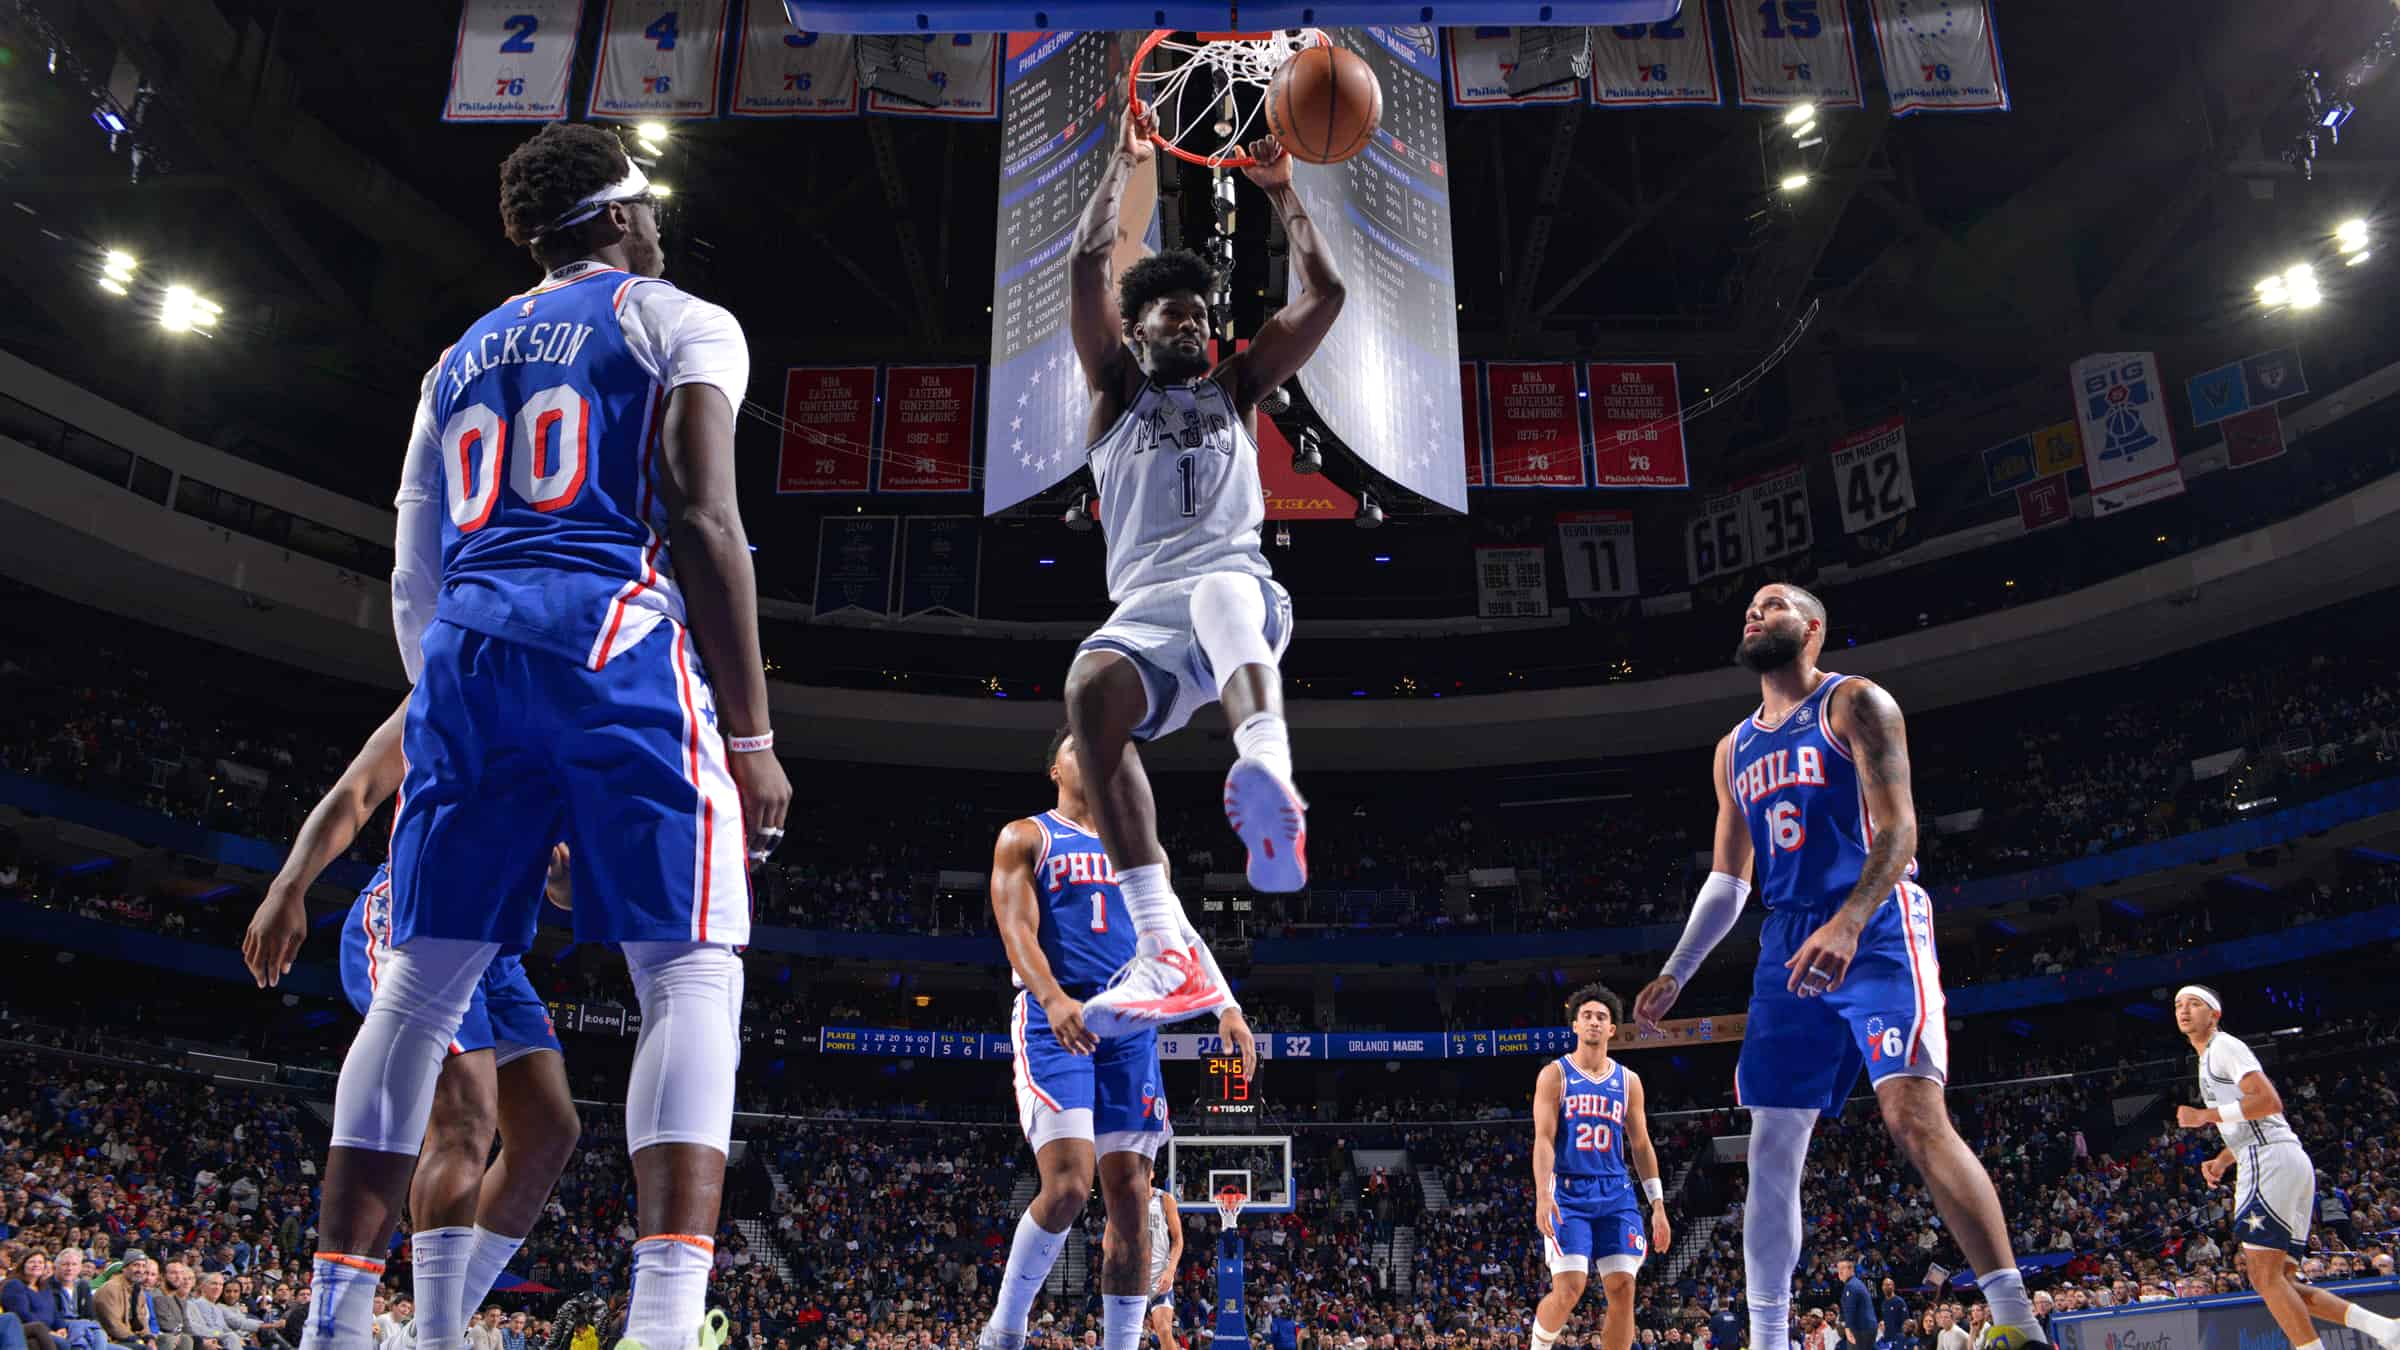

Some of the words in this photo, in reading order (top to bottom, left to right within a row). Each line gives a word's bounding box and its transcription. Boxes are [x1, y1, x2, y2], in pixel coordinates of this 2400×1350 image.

[500, 14, 538, 53] 2
[645, 12, 679, 50] 4
[1637, 64, 1667, 82] 76
[1782, 64, 1811, 81] 76
[1921, 64, 1951, 82] 76
[496, 78, 524, 96] 76
[641, 76, 671, 93] 76
[784, 73, 811, 91] 76
[458, 102, 524, 112] Philadelphia
[447, 322, 594, 401] JACKSON
[2086, 361, 2144, 394] BIG
[808, 388, 852, 399] EASTERN
[908, 387, 952, 399] EASTERN
[1511, 384, 1557, 394] EASTERN
[1611, 384, 1654, 395] EASTERN
[800, 400, 859, 411] CONFERENCE
[899, 400, 960, 411] CONFERENCE
[1504, 396, 1565, 407] CONFERENCE
[1604, 396, 1664, 407] CONFERENCE
[800, 412, 857, 423] CHAMPIONS
[901, 411, 958, 422] CHAMPIONS
[1506, 408, 1563, 419] CHAMPIONS
[1608, 408, 1664, 419] CHAMPIONS
[442, 384, 590, 534] 00
[815, 460, 836, 474] 76
[1528, 456, 1550, 470] 76
[1176, 454, 1196, 518] 1
[1848, 452, 1907, 523] 42
[1761, 490, 1808, 555] 35
[1693, 512, 1743, 576] 66
[1580, 541, 1621, 592] 11
[1736, 746, 1829, 817] PHILA
[1765, 800, 1806, 858] 16
[1090, 891, 1109, 933] 1
[605, 1016, 620, 1026] PM
[826, 1031, 856, 1040] PLAYER
[888, 1034, 900, 1042] 20
[905, 1035, 914, 1043] 16
[917, 1035, 930, 1043] 00
[1498, 1032, 1528, 1041] PLAYER
[1534, 1032, 1540, 1040] 4
[1547, 1031, 1554, 1039] 0
[1561, 1031, 1571, 1039] 21
[826, 1042, 856, 1050] POINTS
[919, 1046, 926, 1054] 0
[943, 1044, 951, 1056] 5
[963, 1046, 972, 1056] 6
[1162, 1041, 1178, 1054] 13
[1286, 1037, 1312, 1057] 32
[1348, 1040, 1389, 1052] ORLANDO
[1393, 1039, 1424, 1052] MAGIC
[1456, 1043, 1465, 1055] 3
[1476, 1043, 1485, 1054] 6
[1499, 1043, 1528, 1052] POINTS
[1867, 1027, 1904, 1063] 76
[1209, 1059, 1243, 1074] 24.6
[1223, 1074, 1249, 1101] 13
[1141, 1096, 1164, 1121] 76
[1219, 1104, 1255, 1114] TISSOT
[1565, 1094, 1625, 1124] PHILA
[1576, 1123, 1614, 1153] 20
[1628, 1233, 1645, 1251] 76
